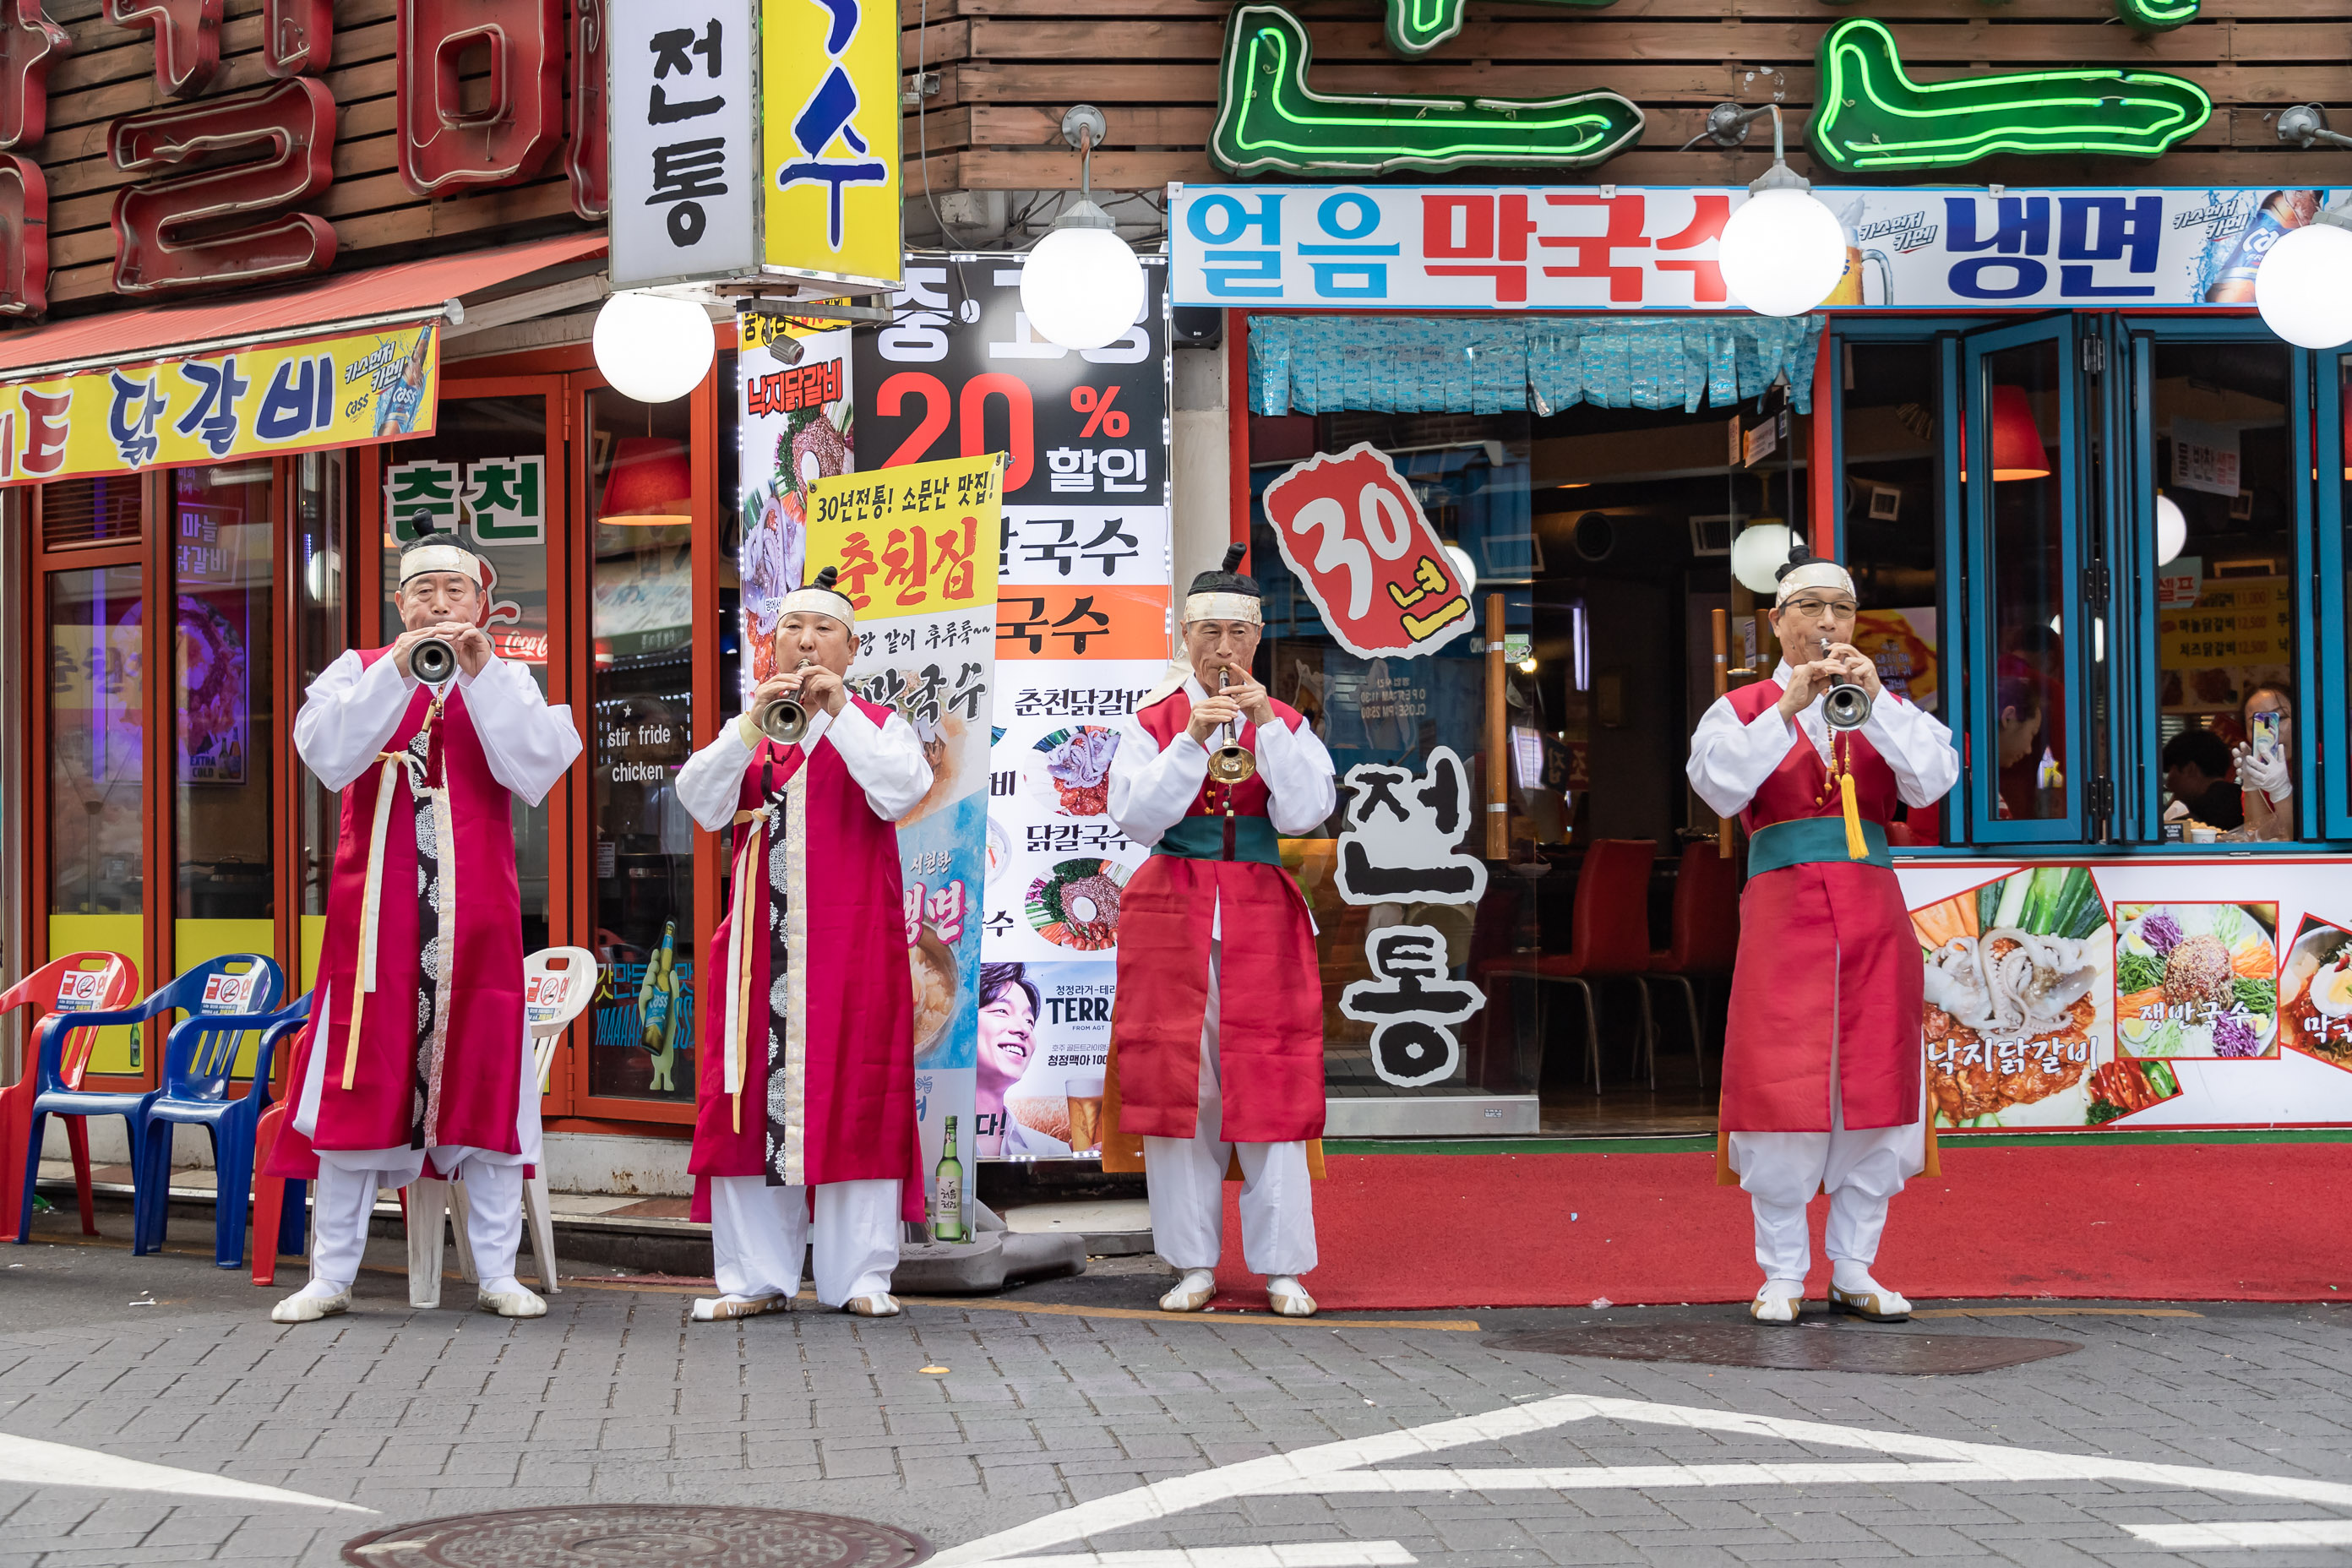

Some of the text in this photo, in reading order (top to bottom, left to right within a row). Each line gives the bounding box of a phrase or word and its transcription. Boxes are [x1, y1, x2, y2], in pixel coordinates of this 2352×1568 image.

[645, 18, 729, 248] 전통
[779, 0, 887, 248] 수
[1186, 193, 1730, 302] 얼음 막국수
[1943, 195, 2163, 300] 냉면
[392, 386, 417, 406] Cass
[749, 357, 843, 418] 낙지닭갈비
[110, 352, 335, 467] 닭갈비
[876, 372, 1130, 493] 20 %
[1046, 446, 1146, 493] 할인
[385, 456, 545, 546] 춘천
[816, 471, 996, 523] 30년전통! 소문난 맛집!
[182, 512, 218, 542] 마늘
[831, 516, 978, 611] 춘천집
[885, 629, 916, 654] 같이
[608, 724, 671, 747] stir fride
[190, 755, 216, 767] EXTRA
[192, 767, 215, 778] COLD
[612, 762, 664, 782] chicken
[910, 850, 953, 875] 시원한
[1342, 752, 1478, 1080] 전통
[1045, 997, 1113, 1025] TERR
[2138, 1000, 2252, 1032] 쟁반국수
[1048, 1054, 1091, 1066] 청정맥아
[1927, 1036, 2099, 1075] 낙지닭갈비
[940, 1189, 957, 1200] 처음
[940, 1200, 958, 1210] 처럼
